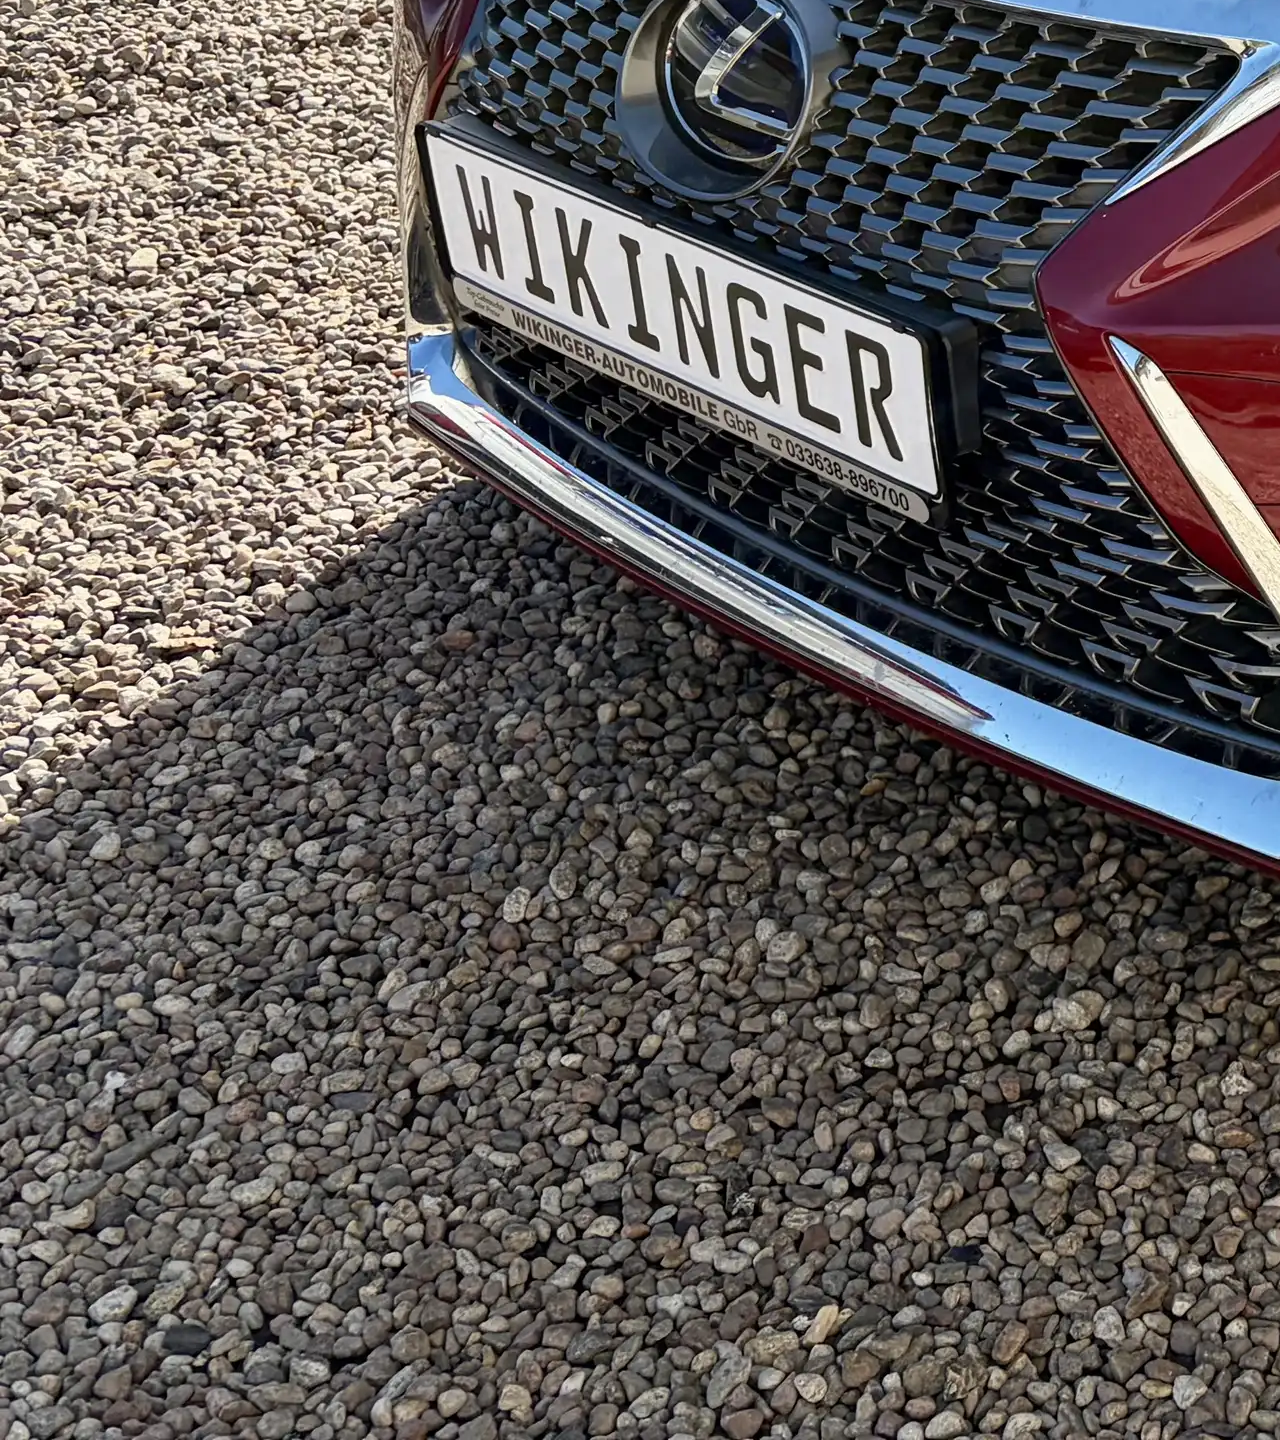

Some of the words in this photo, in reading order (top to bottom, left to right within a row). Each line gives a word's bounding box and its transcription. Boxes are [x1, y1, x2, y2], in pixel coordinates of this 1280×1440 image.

[455, 164, 904, 463] WIKINGER
[511, 309, 720, 422] WIKINGER-AUTOMOBILE
[723, 409, 760, 441] GbR
[785, 438, 910, 512] 033638-896700
